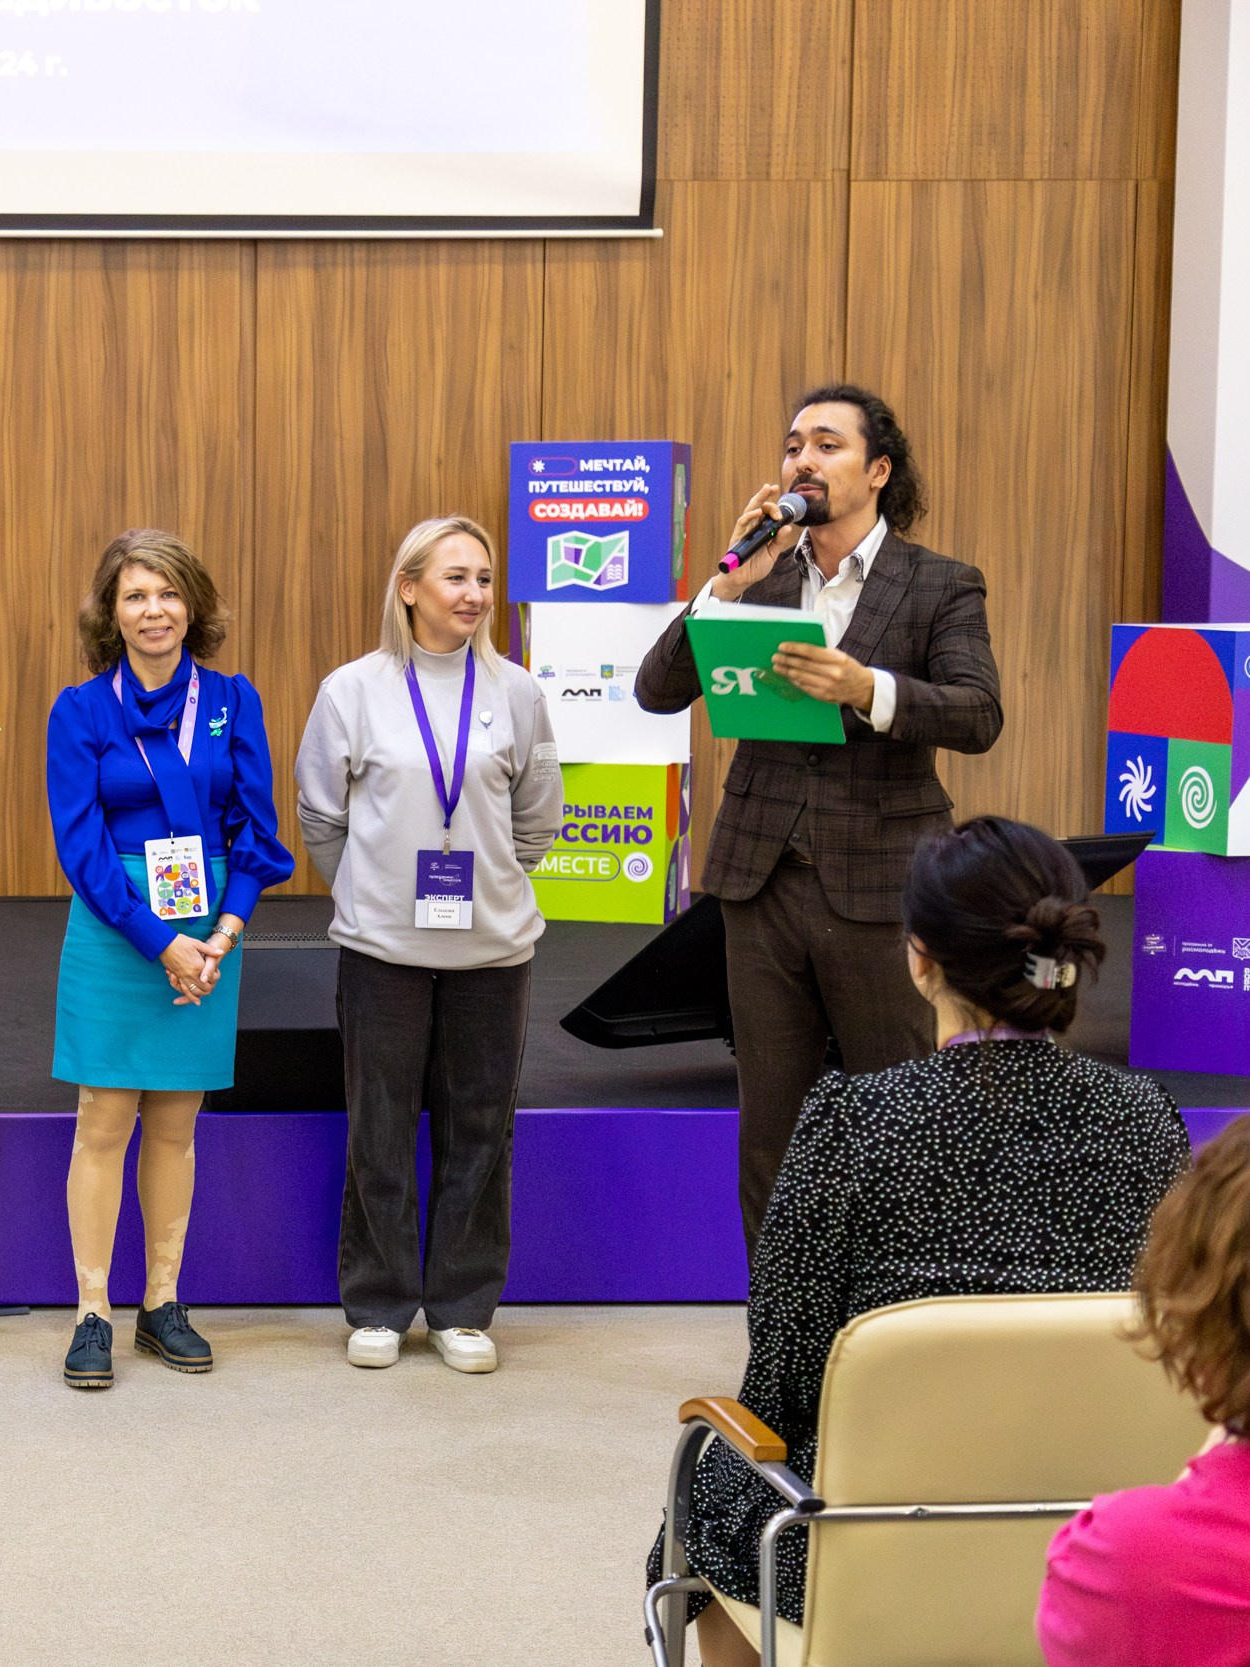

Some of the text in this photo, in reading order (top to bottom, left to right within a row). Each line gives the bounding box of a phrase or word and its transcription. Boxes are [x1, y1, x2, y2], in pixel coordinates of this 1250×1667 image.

[45, 56, 68, 76] г.
[579, 456, 650, 473] МЕЧТАЙ,
[528, 477, 649, 494] ПУТЕШЕСТВУЙ,
[534, 499, 644, 519] СОЗДАВАЙ!
[563, 804, 653, 820] РЫВАЕМ
[554, 823, 653, 845] ССИЮ
